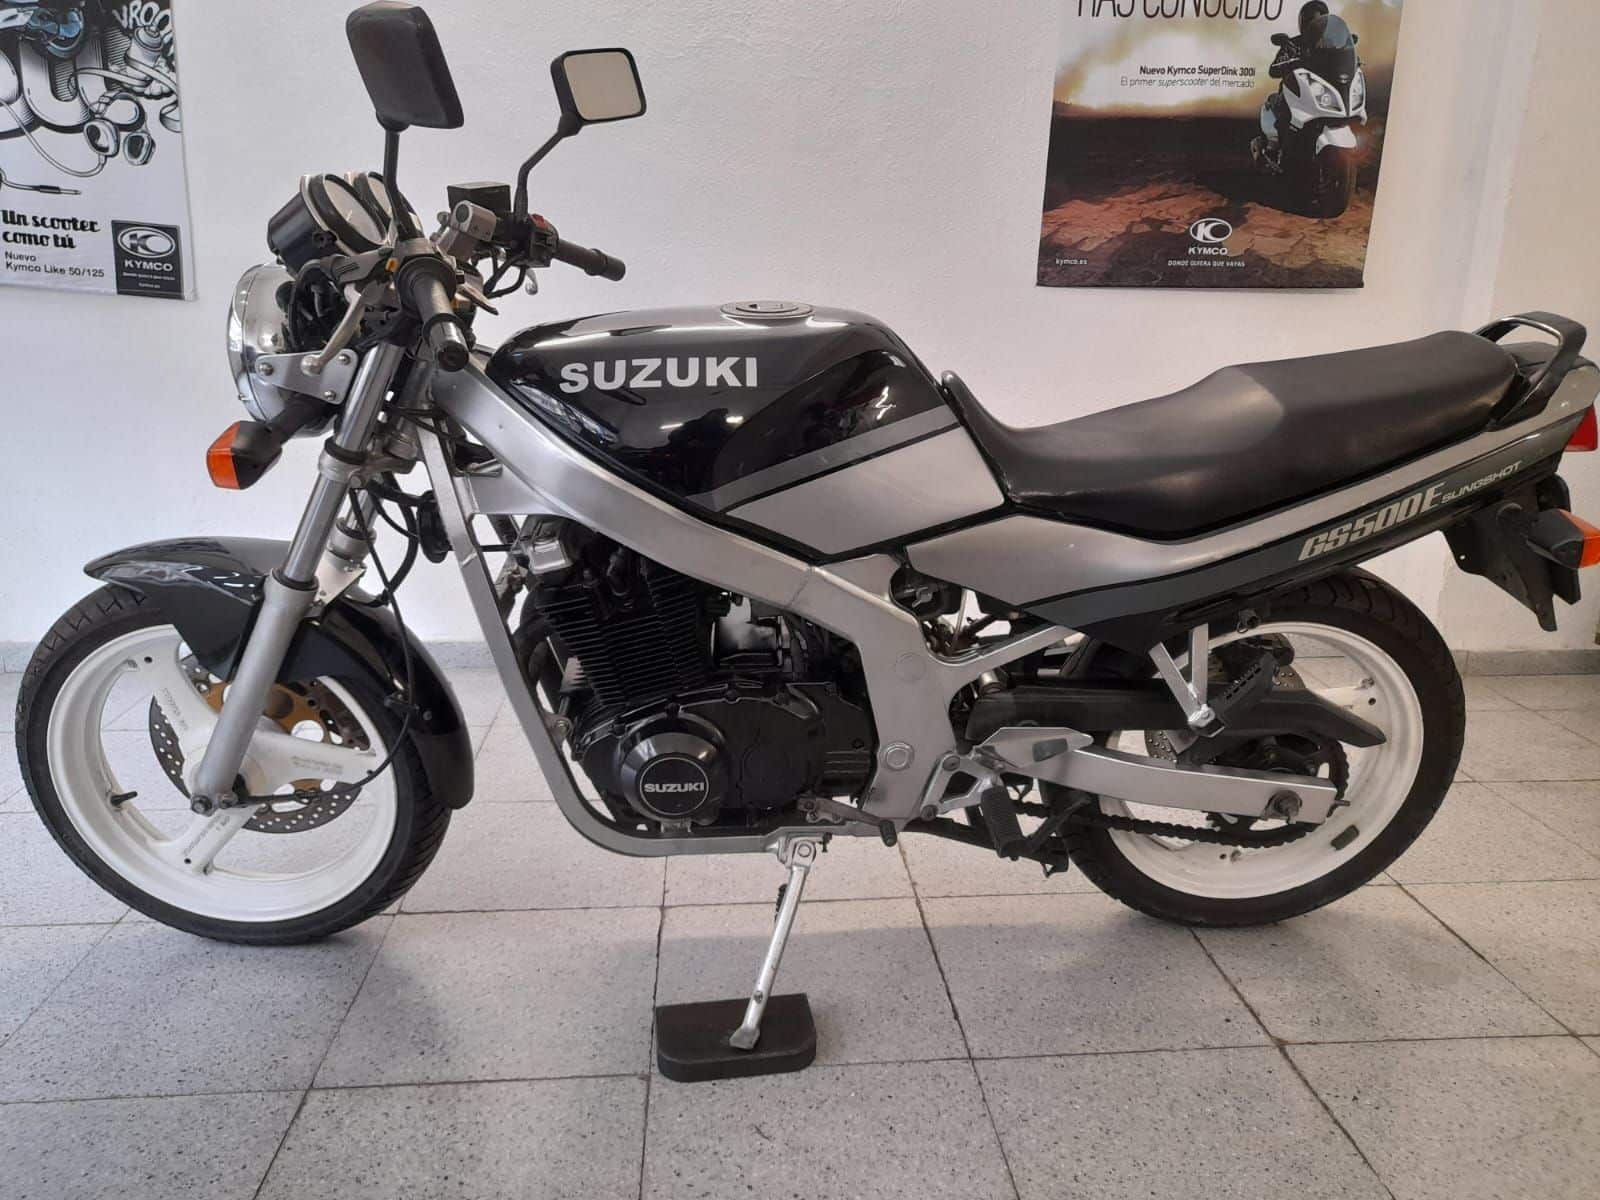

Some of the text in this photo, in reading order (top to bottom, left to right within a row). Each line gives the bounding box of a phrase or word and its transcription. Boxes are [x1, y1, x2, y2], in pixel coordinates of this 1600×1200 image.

[1139, 65, 1165, 75] Nuevo
[1167, 65, 1196, 77] Kymco
[1198, 65, 1237, 77] SuperDink
[1120, 76, 1128, 86] El
[1129, 78, 1156, 88] primer
[1158, 77, 1207, 88] superscooter
[1210, 77, 1221, 87] del
[0, 209, 100, 232] Un scooter
[2, 231, 76, 249] como tú
[4, 251, 37, 262] Nuevo
[1187, 247, 1228, 255] KYMCO
[5, 261, 105, 278] Kymco Like 50/125
[124, 259, 173, 272] KYMCO
[559, 356, 758, 394] SUZUKI
[1298, 460, 1523, 561] GS500E SLINGSHOT
[643, 782, 705, 793] SUZUKI
